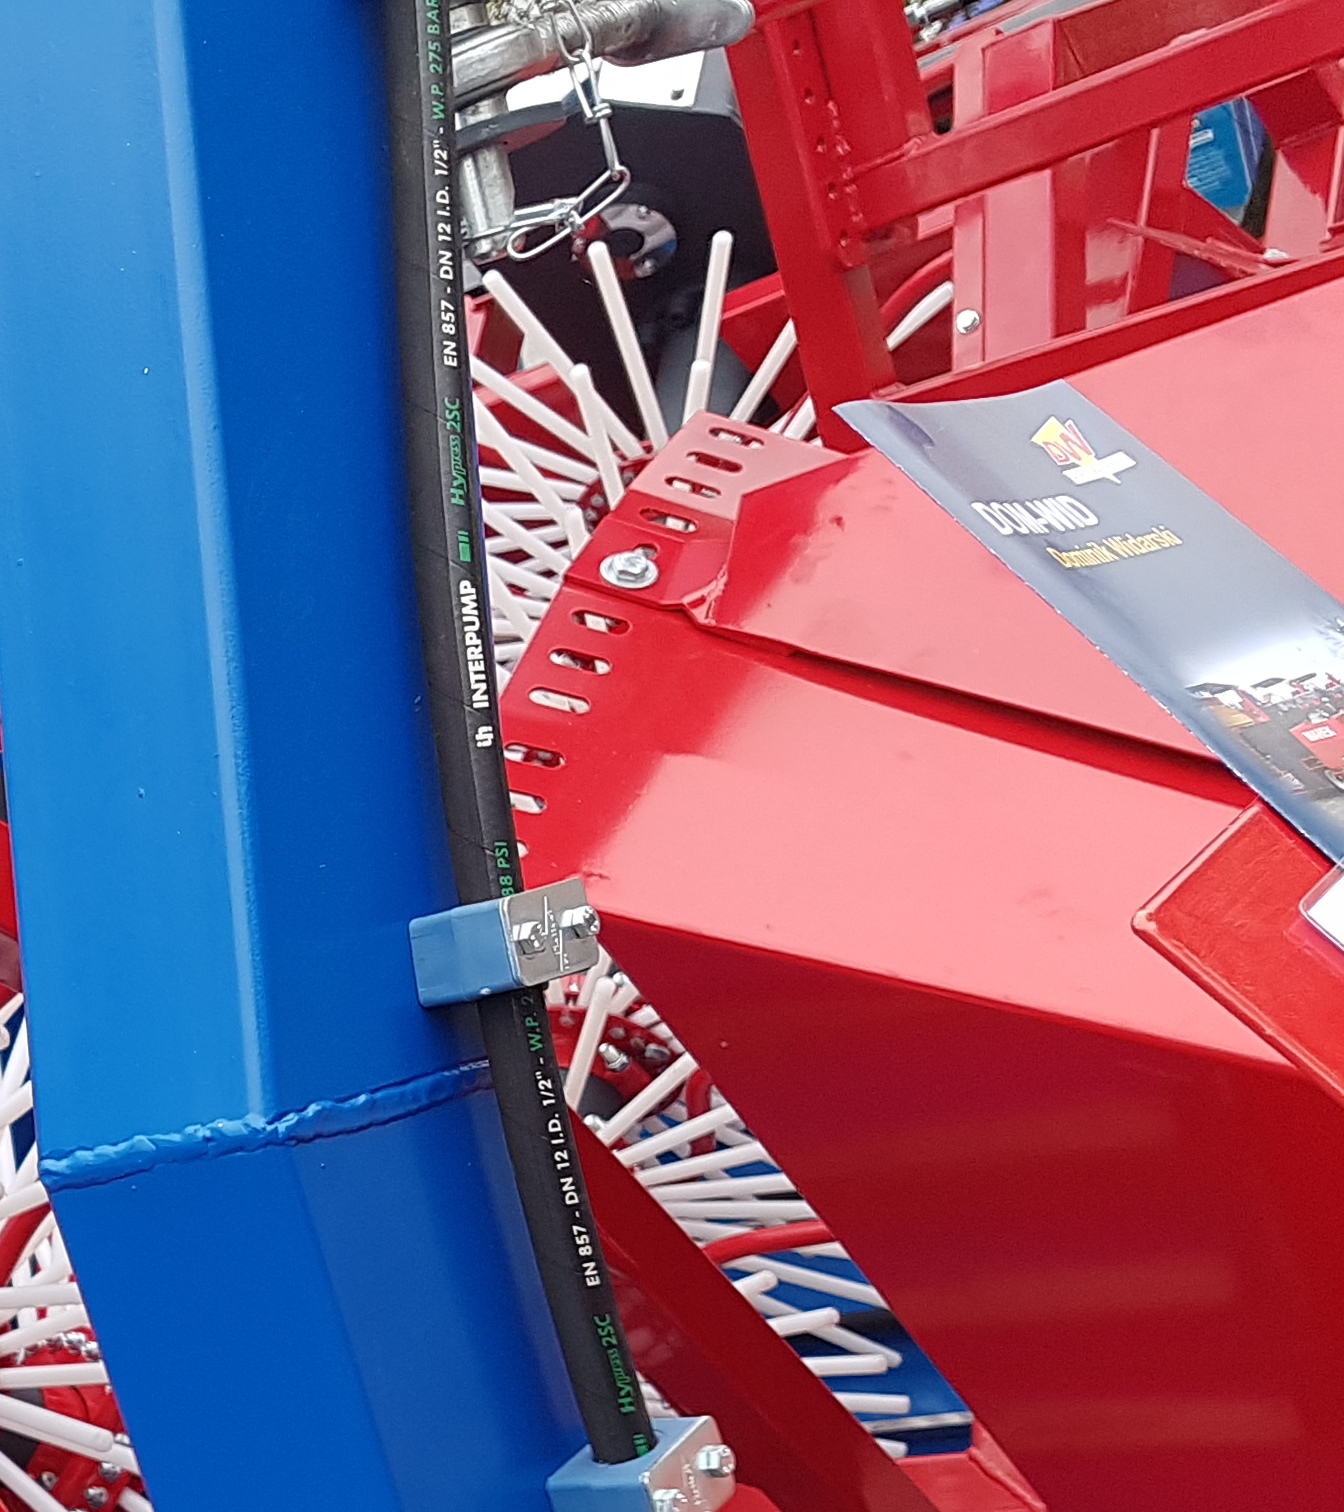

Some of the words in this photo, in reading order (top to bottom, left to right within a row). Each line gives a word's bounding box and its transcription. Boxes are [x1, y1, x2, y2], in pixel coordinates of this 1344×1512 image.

[427, 40, 443, 75] 275
[433, 139, 449, 176] 1/2"
[435, 186, 451, 217] I.D.
[437, 222, 452, 242] 12
[438, 250, 454, 280] DN
[440, 299, 456, 335] 857
[443, 340, 458, 367] EN
[444, 396, 461, 433] 2SC
[970, 495, 1099, 536] DOM-WID
[1045, 542, 1120, 569] Dominik
[1105, 525, 1183, 558] Widarski
[459, 579, 490, 709] INTERPUMP
[494, 841, 509, 869] PSI
[535, 1070, 556, 1107] 1/2"
[547, 1112, 566, 1145] I.D.
[553, 1149, 570, 1170] 12
[560, 1176, 580, 1206] DN
[572, 1224, 593, 1257] 857
[582, 1261, 601, 1287] EN
[593, 1313, 619, 1348] 2SC
